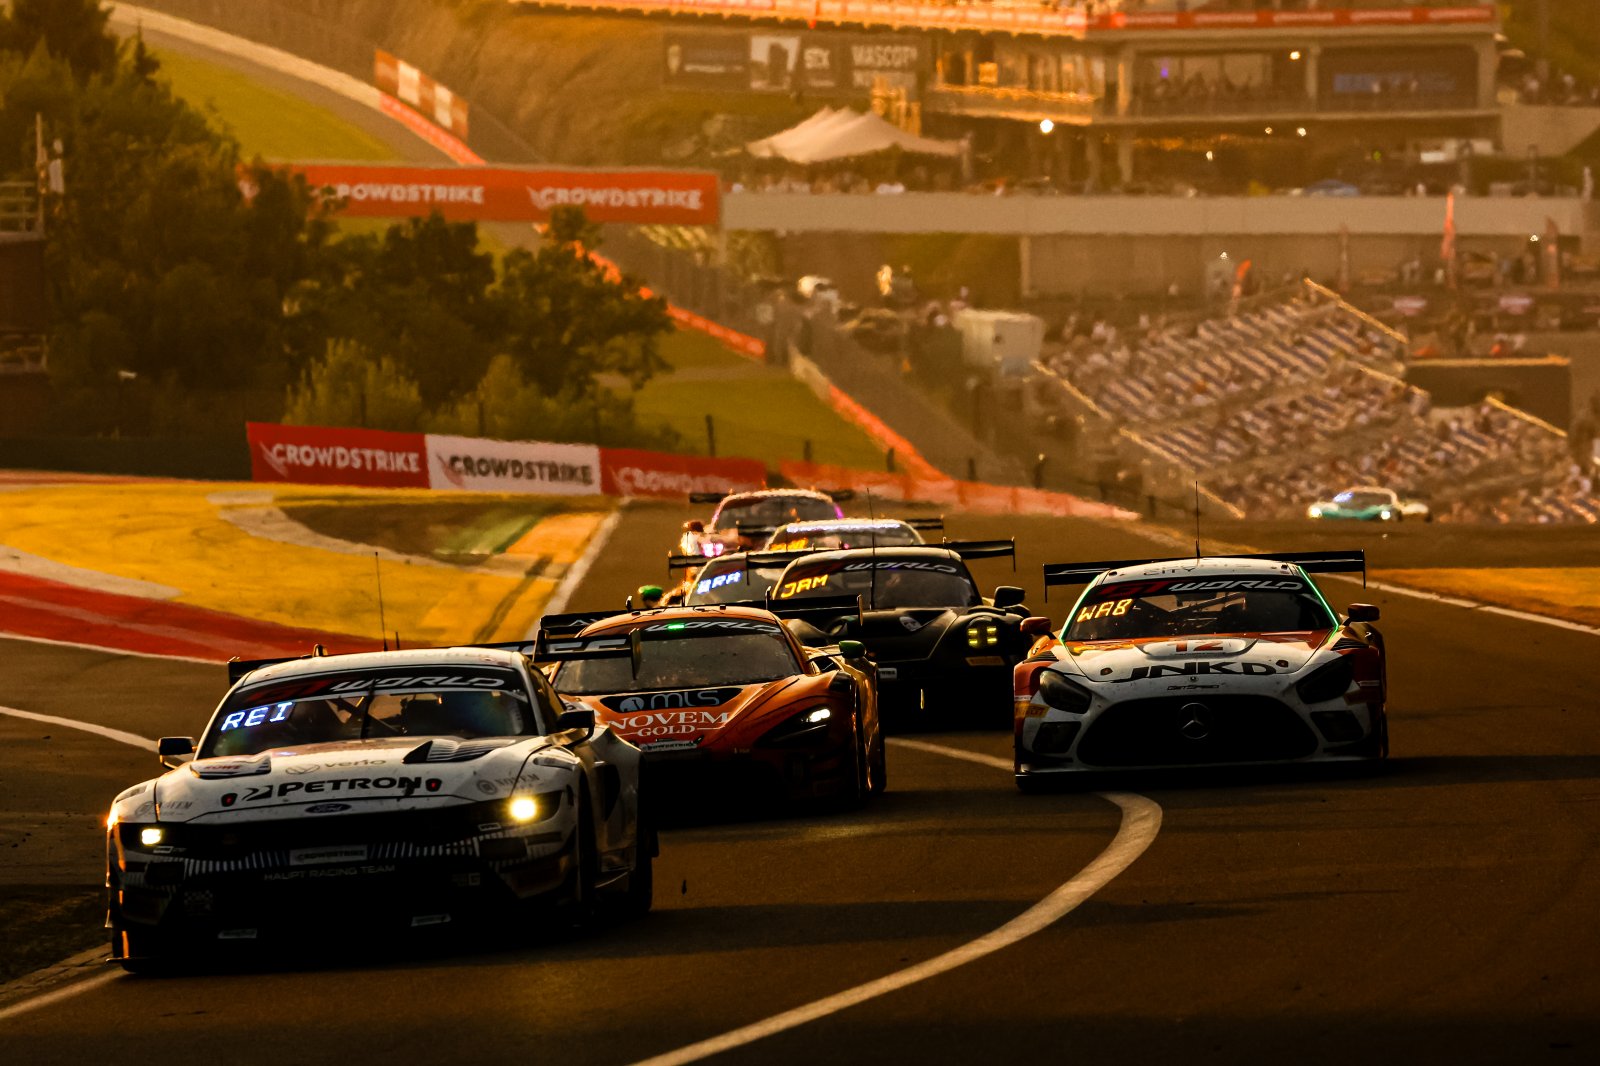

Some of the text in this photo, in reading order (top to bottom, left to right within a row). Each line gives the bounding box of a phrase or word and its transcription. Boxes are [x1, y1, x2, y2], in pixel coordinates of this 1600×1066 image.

[541, 186, 703, 210] CROWDSTRIKE
[271, 442, 421, 473] CROWDSTRIKE
[450, 454, 593, 485] CROWDSTRIKE
[844, 562, 957, 574] WORLD
[781, 574, 829, 599] JAM
[1169, 580, 1304, 592] WORLD
[1077, 598, 1134, 623] WAB
[331, 676, 505, 692] WORLD
[220, 702, 293, 732] REI
[607, 711, 731, 730] NOVEM
[637, 724, 696, 737] GOLD
[277, 776, 423, 797] PETRON
[309, 867, 358, 878] RACING
[361, 864, 396, 874] TEAM
